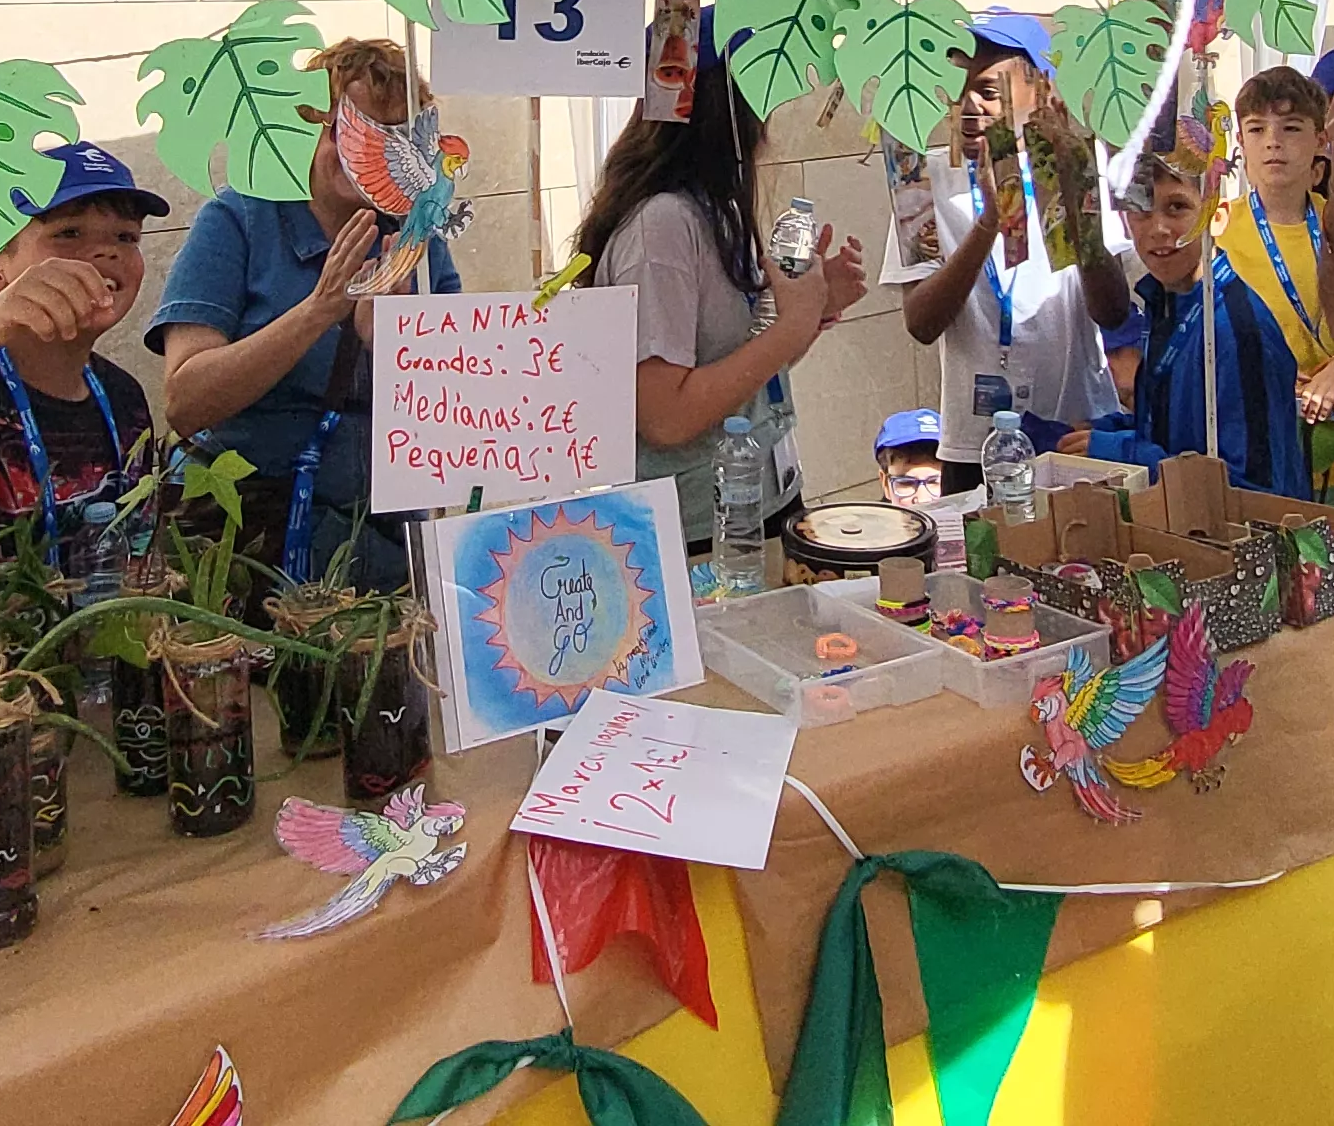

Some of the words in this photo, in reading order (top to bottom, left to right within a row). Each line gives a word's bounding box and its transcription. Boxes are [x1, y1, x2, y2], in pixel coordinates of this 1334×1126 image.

[576, 58, 611, 67] iberCaja
[396, 344, 508, 376] Grandes:
[521, 337, 565, 376] 3€
[539, 400, 579, 435] 2€
[387, 429, 553, 485] Pequeñas:
[566, 435, 599, 479] 1€
[540, 556, 596, 601] Create
[554, 594, 584, 624] And
